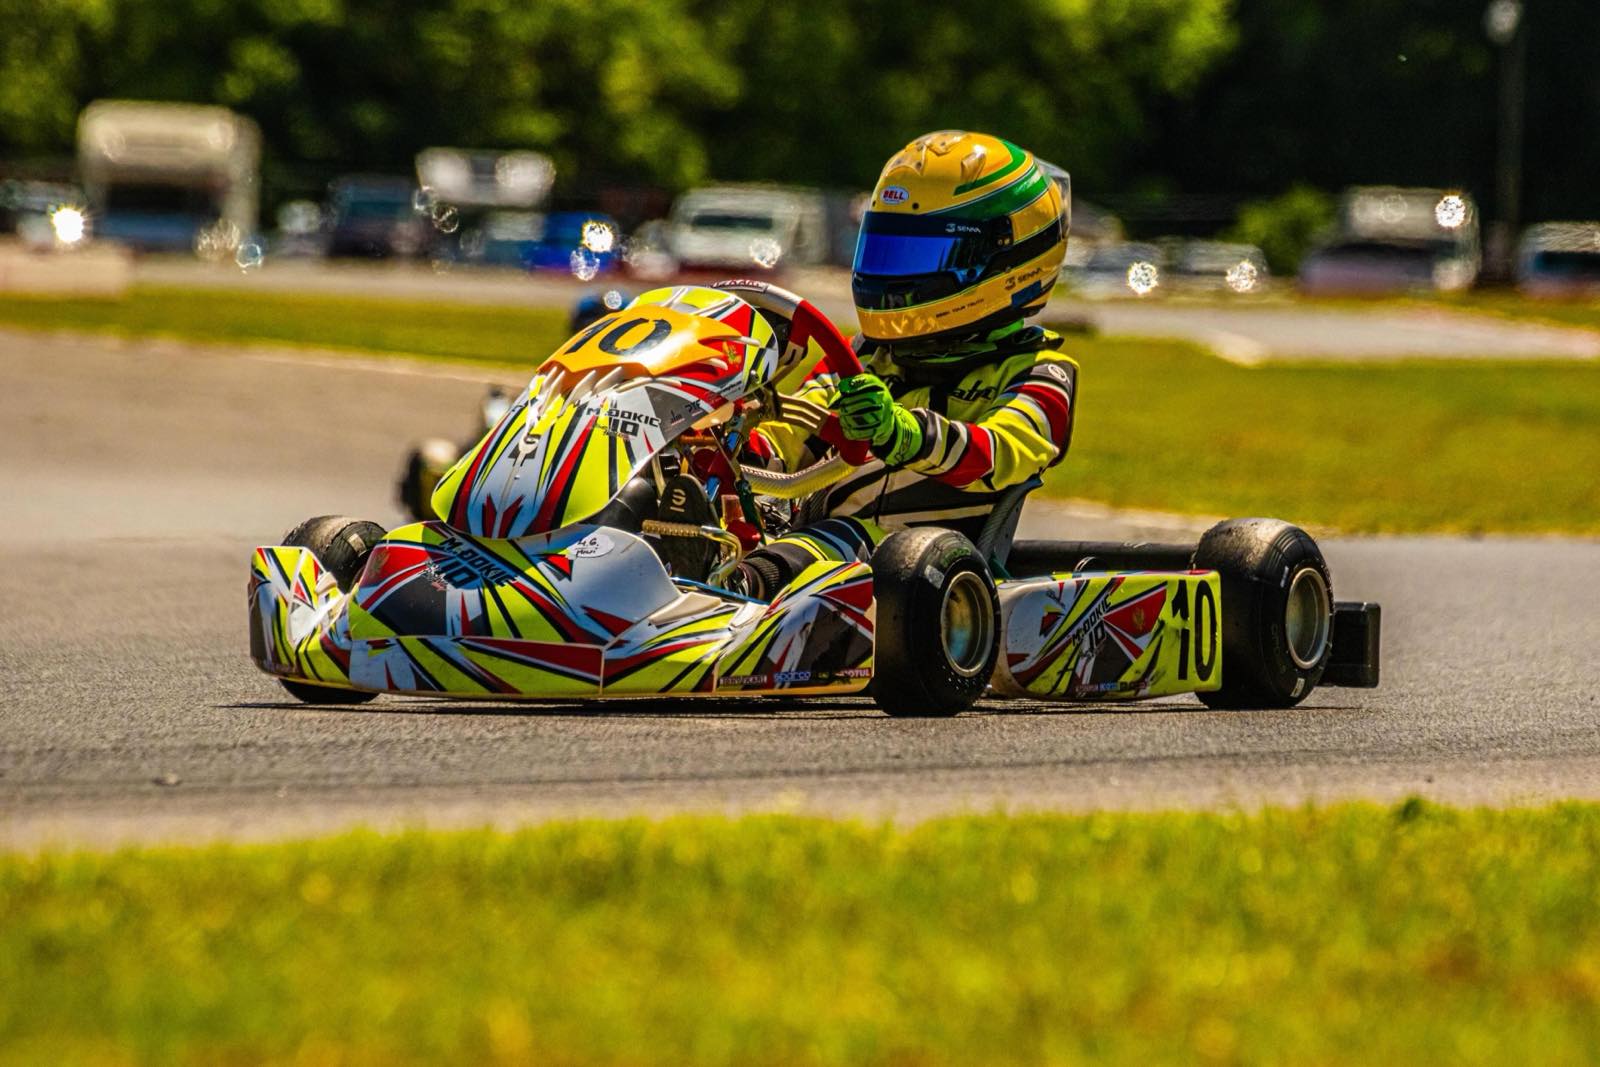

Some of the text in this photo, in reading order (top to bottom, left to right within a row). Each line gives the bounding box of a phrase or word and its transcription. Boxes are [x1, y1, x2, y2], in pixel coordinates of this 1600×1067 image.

[883, 189, 905, 201] BELL
[563, 317, 672, 354] 10
[1171, 579, 1217, 682] 10
